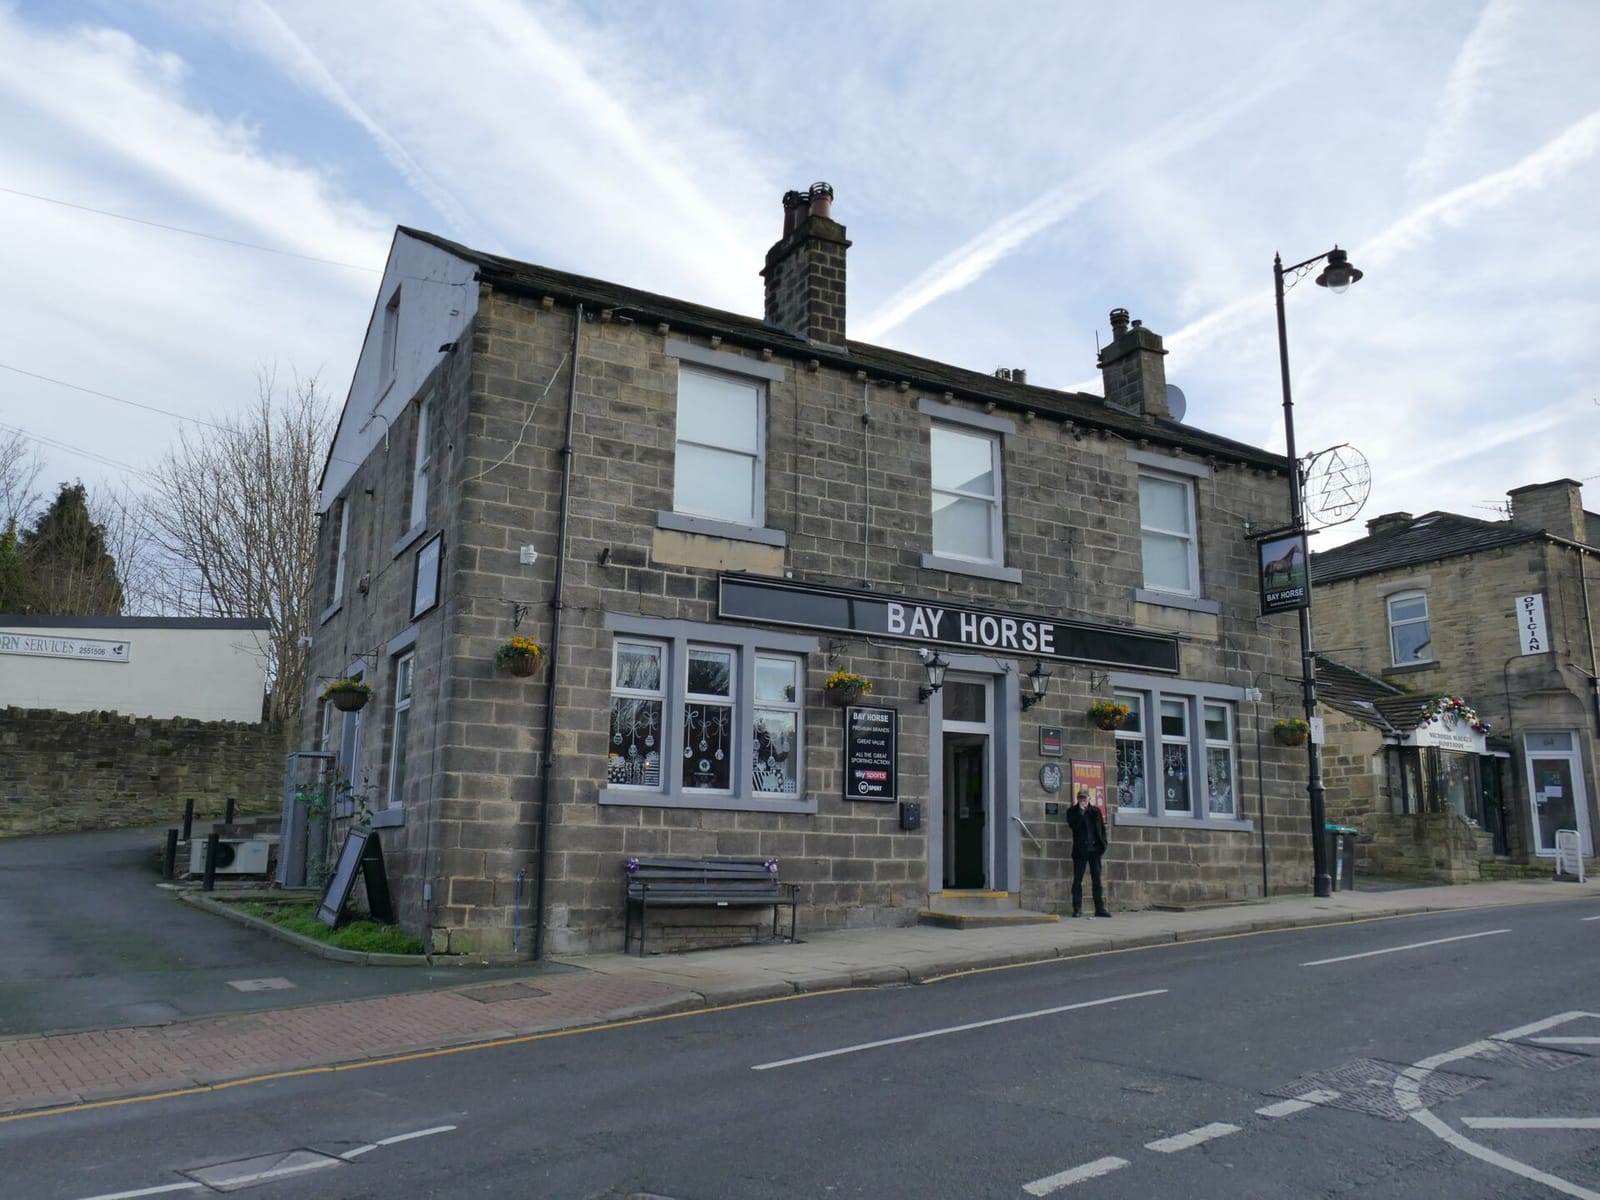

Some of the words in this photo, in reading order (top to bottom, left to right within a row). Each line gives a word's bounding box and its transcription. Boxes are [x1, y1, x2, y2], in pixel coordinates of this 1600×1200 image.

[1266, 592, 1280, 602] BAY
[1280, 587, 1304, 600] HORSE
[887, 603, 944, 638] BAY
[960, 613, 1055, 653] HORSE
[1523, 596, 1540, 651] OPTICIAN
[0, 636, 21, 649] RN
[24, 638, 75, 654] SERVICES
[79, 646, 106, 656] 2551506
[853, 712, 866, 721] BAY
[867, 713, 889, 723] HORSE
[855, 770, 866, 779] sky
[866, 771, 887, 780] sports
